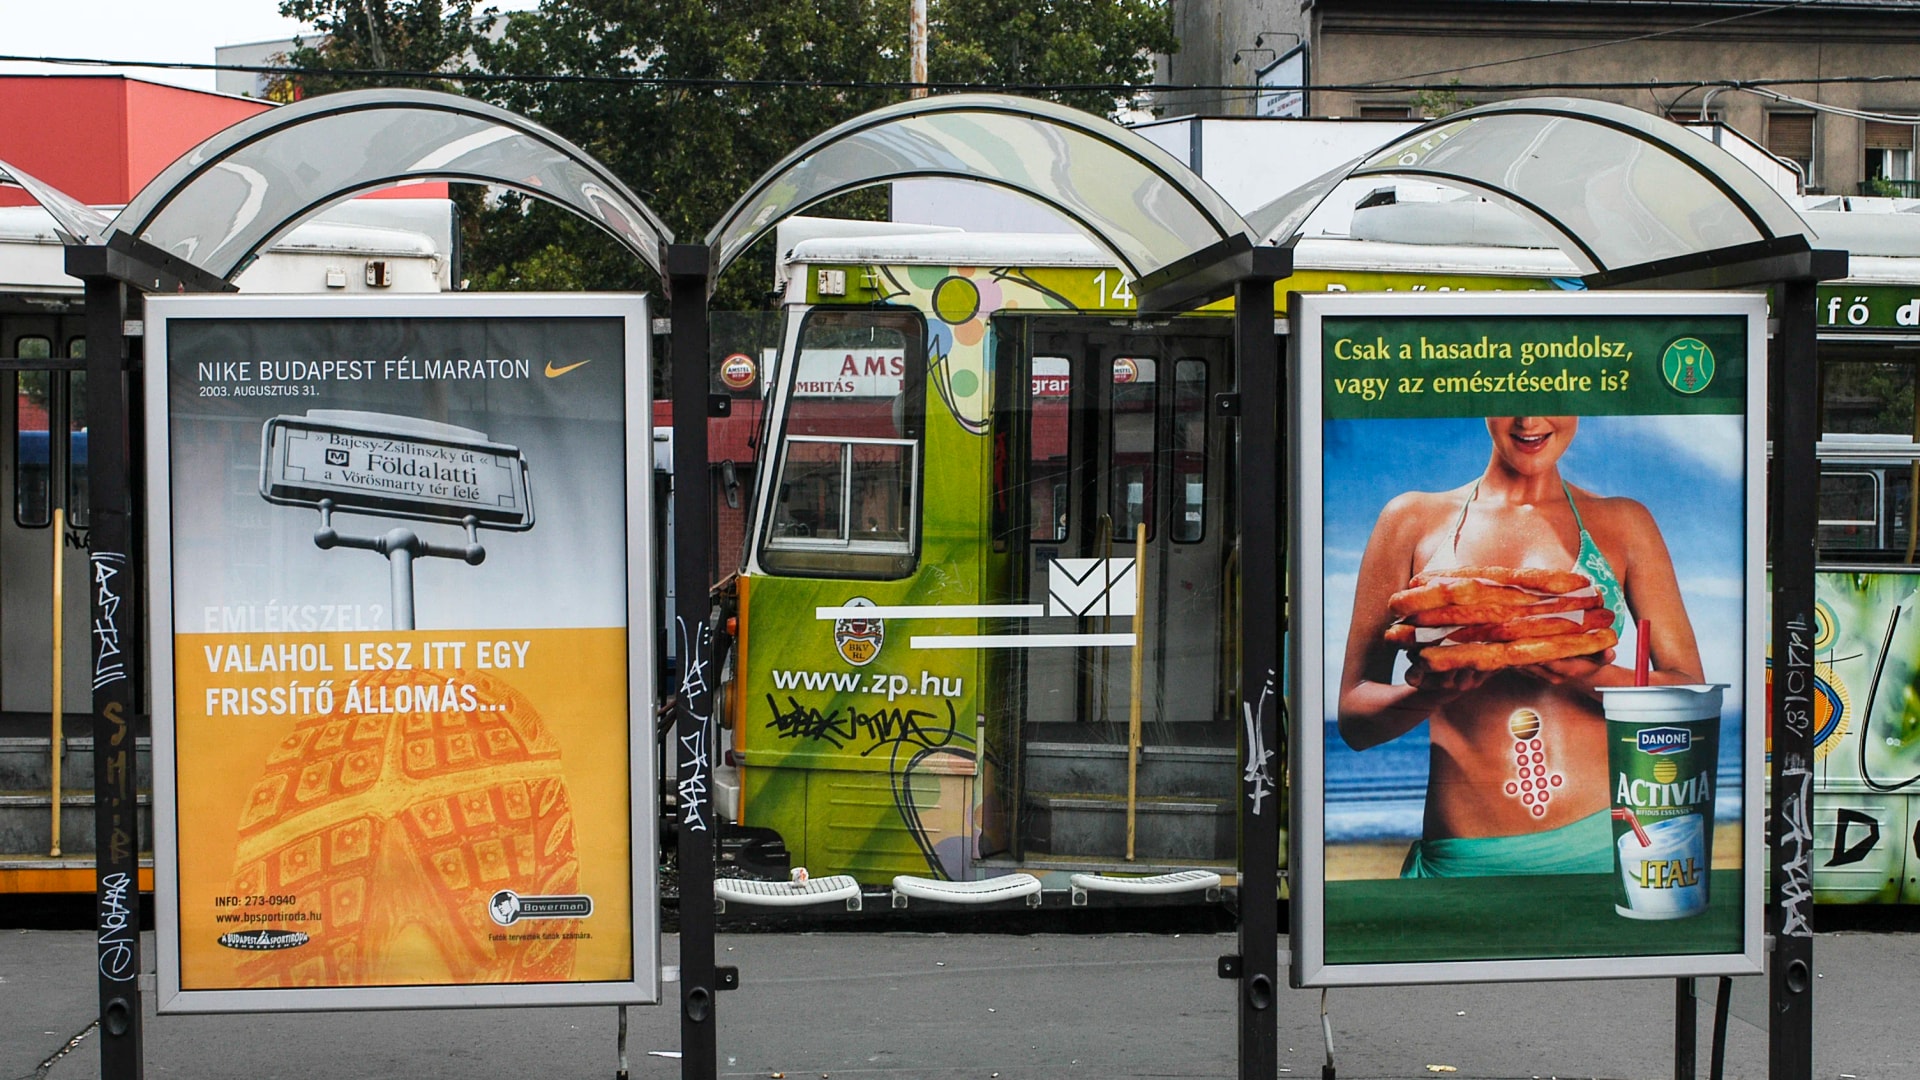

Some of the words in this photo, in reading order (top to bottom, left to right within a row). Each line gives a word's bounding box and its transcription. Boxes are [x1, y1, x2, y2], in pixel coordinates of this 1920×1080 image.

[1093, 270, 1134, 308] 14
[1334, 336, 1390, 360] Csak
[1399, 343, 1412, 360] a
[1420, 335, 1512, 359] hasadra
[1520, 335, 1633, 366] gondolsz,
[199, 362, 251, 382] NIKE
[259, 360, 376, 381] BUDAPEST
[384, 355, 529, 380] FÉLMARATON
[1334, 376, 1389, 400] vagy
[1398, 377, 1424, 393] az
[1433, 368, 1592, 393] emésztésedre
[1600, 369, 1630, 392] is?
[200, 386, 230, 397] 2003.
[234, 385, 299, 396] AUGUSZTUS
[302, 385, 319, 396] 31.
[329, 433, 457, 464] Bajcsy-Zsilinszky
[461, 450, 474, 464] út
[324, 471, 332, 480] a
[341, 469, 424, 496] Vörösmarty
[429, 482, 449, 496] tér
[453, 485, 480, 500] felé
[367, 453, 478, 485] Földalatti
[204, 599, 384, 633] EMLÉKSZEL?
[204, 643, 334, 673] VALAHOL
[343, 642, 412, 672] LESZ
[423, 641, 466, 670] ITT
[477, 640, 531, 669] EGY
[849, 643, 869, 651] BKV
[206, 680, 334, 716] FRISSÍTŐ
[343, 678, 506, 714] ÁLLOMÁS...
[772, 670, 962, 701] www.zp.hu
[1641, 733, 1687, 745] DANONE
[1617, 770, 1710, 807] ACTIVIA
[1640, 858, 1699, 889] ITAL
[215, 896, 241, 907] INFO:
[245, 895, 296, 906] 273-0940
[524, 903, 584, 912] Bowerman
[216, 911, 322, 924] www.bpsportiroda.hu
[228, 933, 257, 945] BUDAPEST
